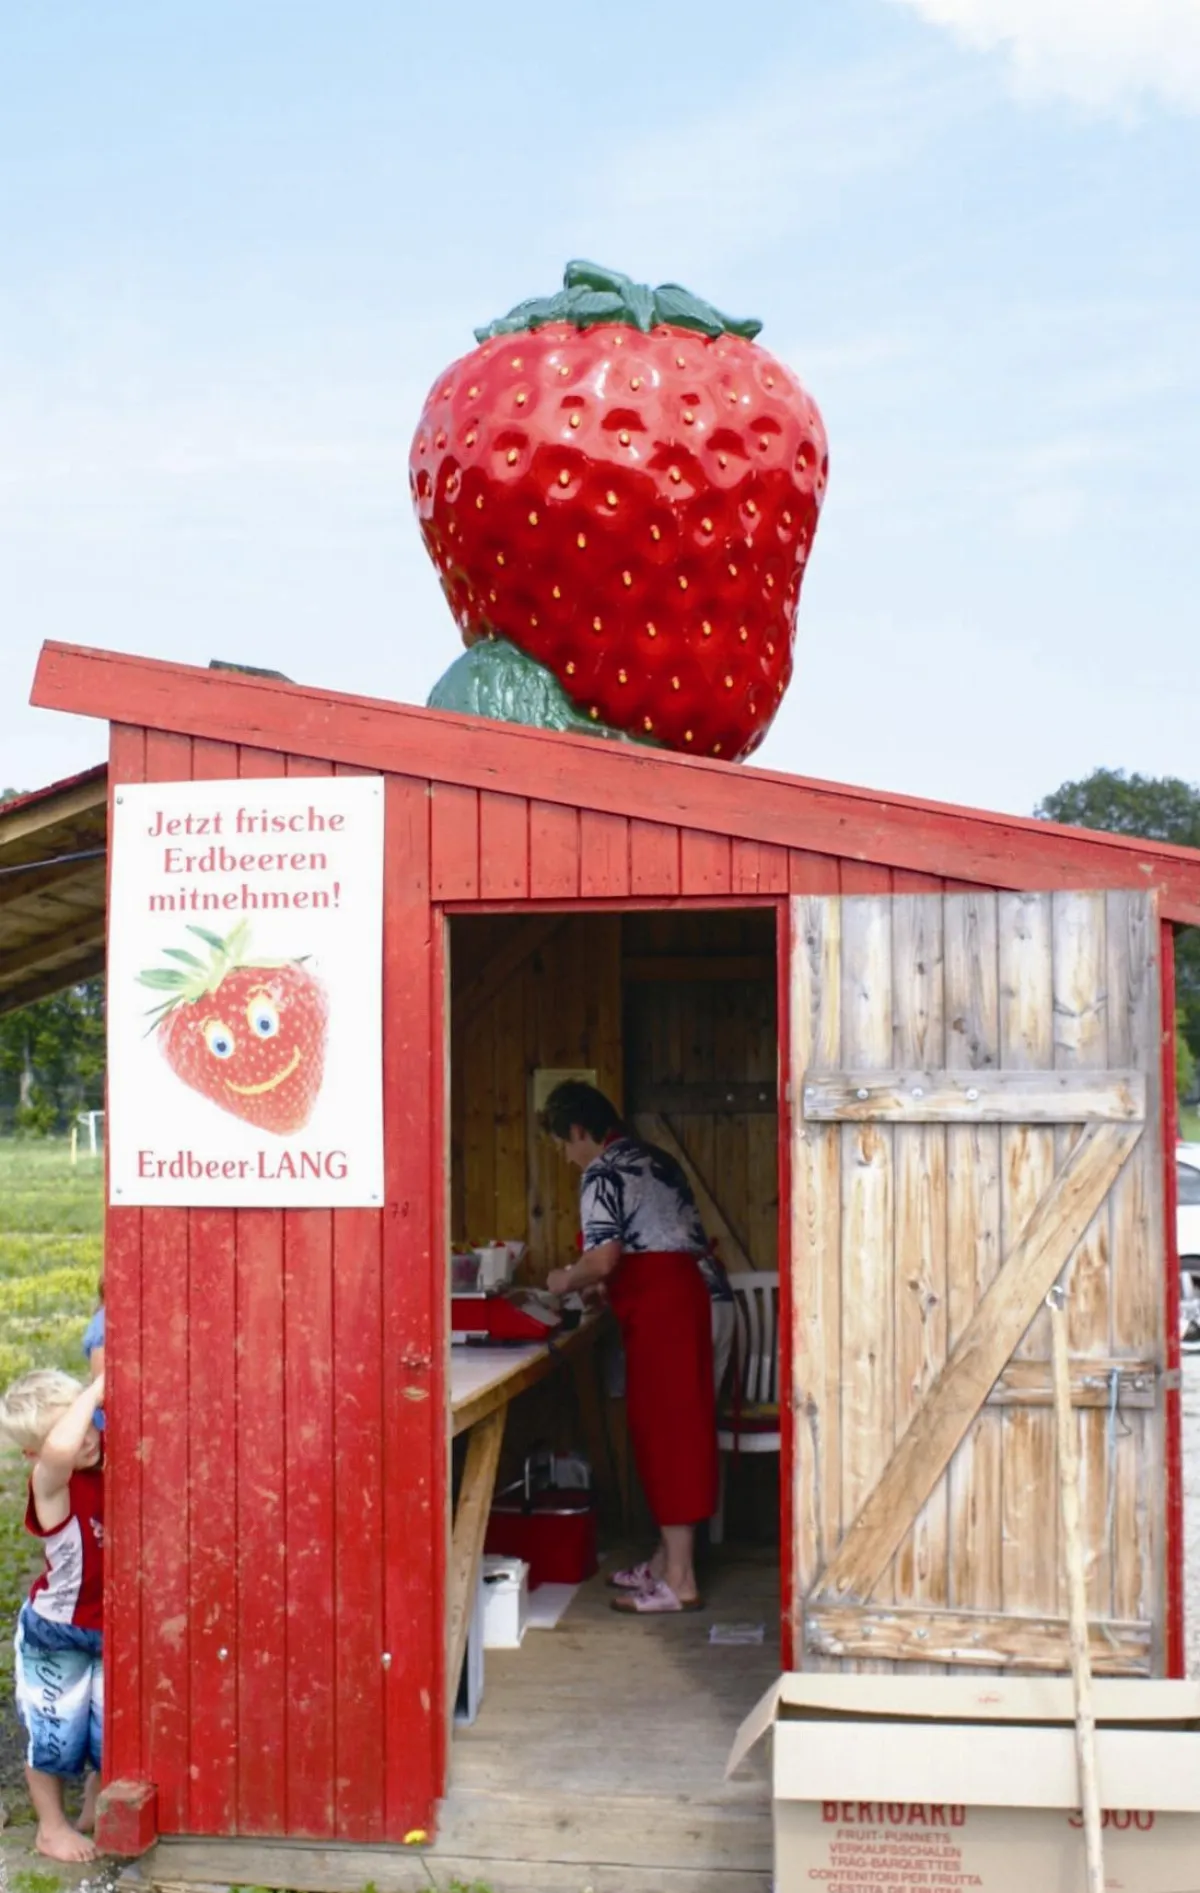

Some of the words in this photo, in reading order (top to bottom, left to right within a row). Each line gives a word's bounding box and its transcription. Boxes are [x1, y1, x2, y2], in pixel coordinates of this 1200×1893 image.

[148, 811, 223, 837] Jetzt
[235, 805, 345, 833] frische
[163, 846, 328, 873] Erdbeeren
[147, 881, 341, 912] mitnehmen!
[137, 1150, 349, 1181] Erdbeer-LANG
[829, 1843, 962, 1857] VERKAUFSSCHALEN
[808, 1869, 899, 1882] CONTENITORI
[901, 1872, 928, 1884] PER
[930, 1874, 983, 1886] FRUTTA
